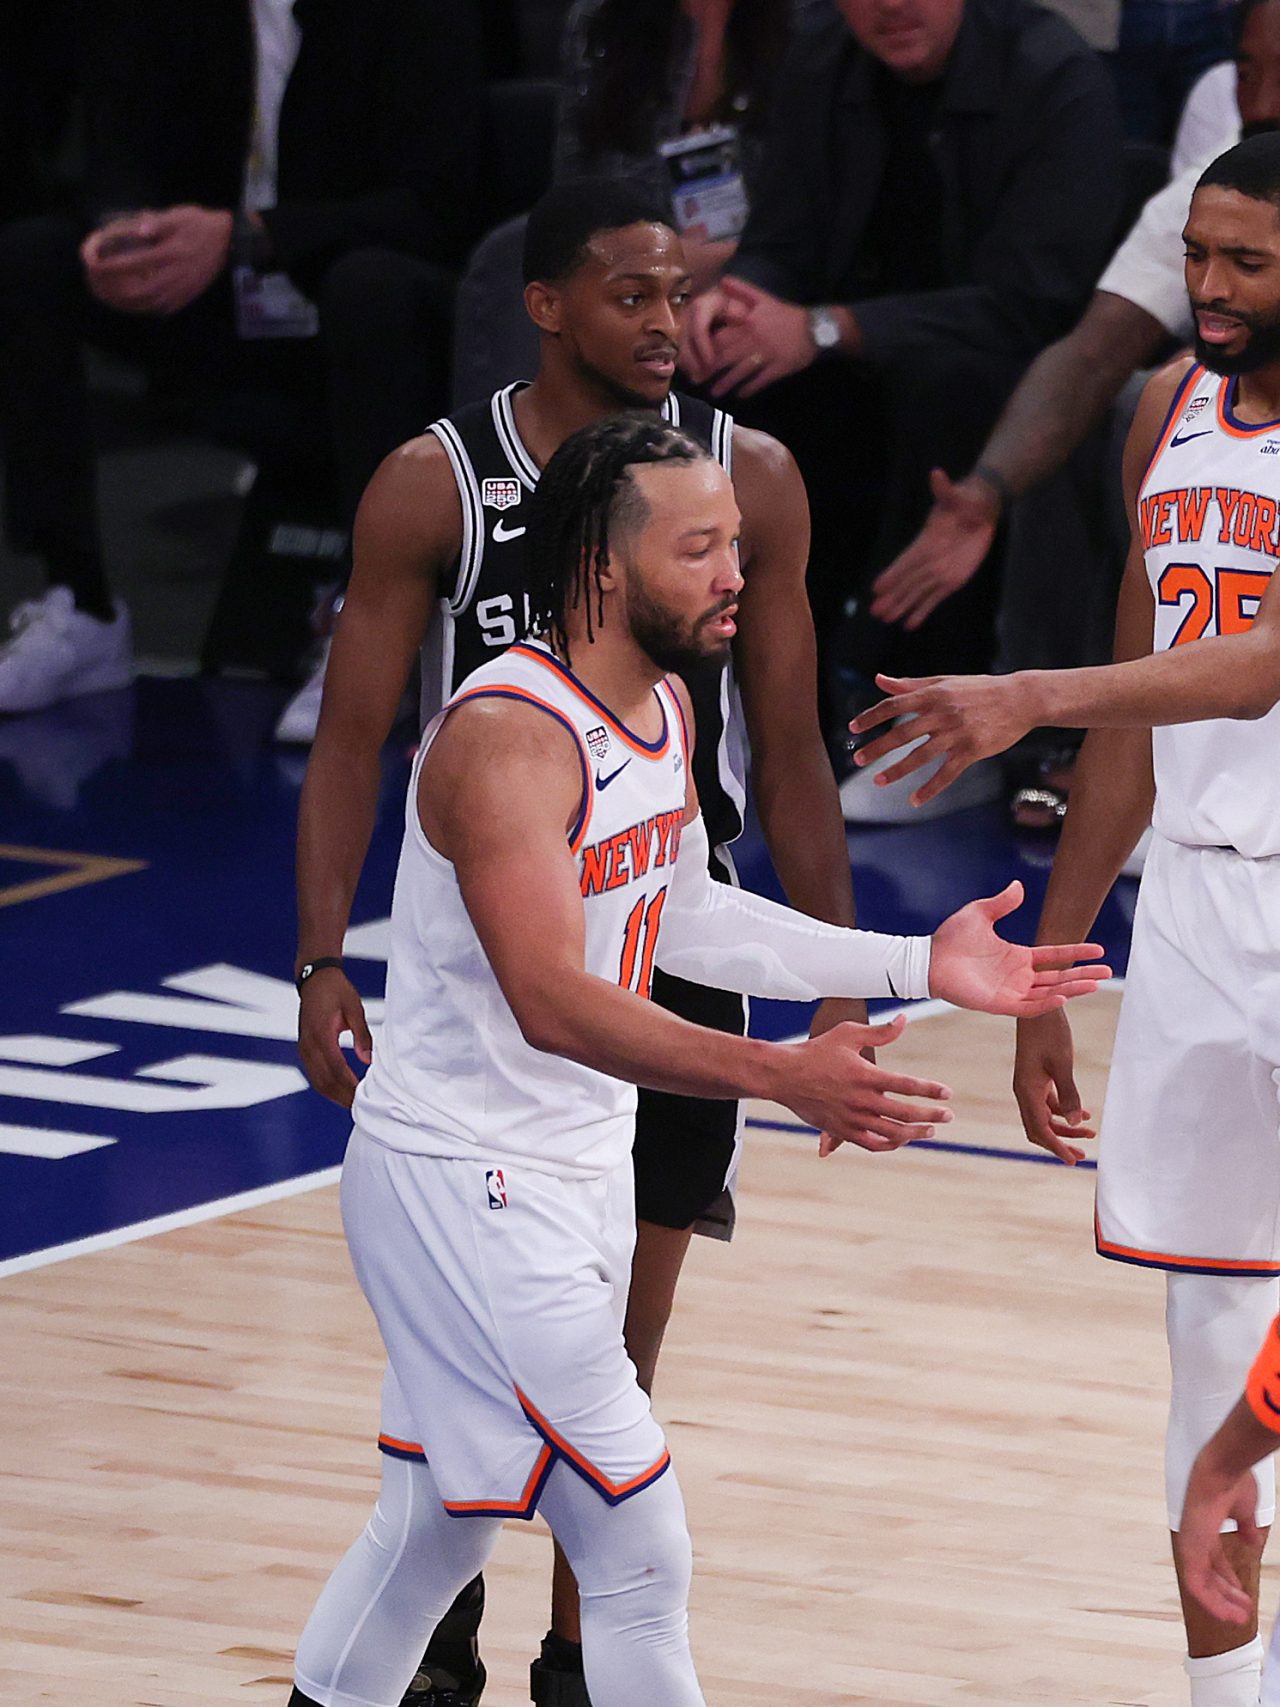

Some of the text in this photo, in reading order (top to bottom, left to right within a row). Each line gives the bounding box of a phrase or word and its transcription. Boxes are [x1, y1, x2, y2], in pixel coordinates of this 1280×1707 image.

[486, 482, 516, 491] USA
[1140, 486, 1212, 550] NEW
[579, 818, 654, 898] NEW
[618, 885, 668, 1000] 11
